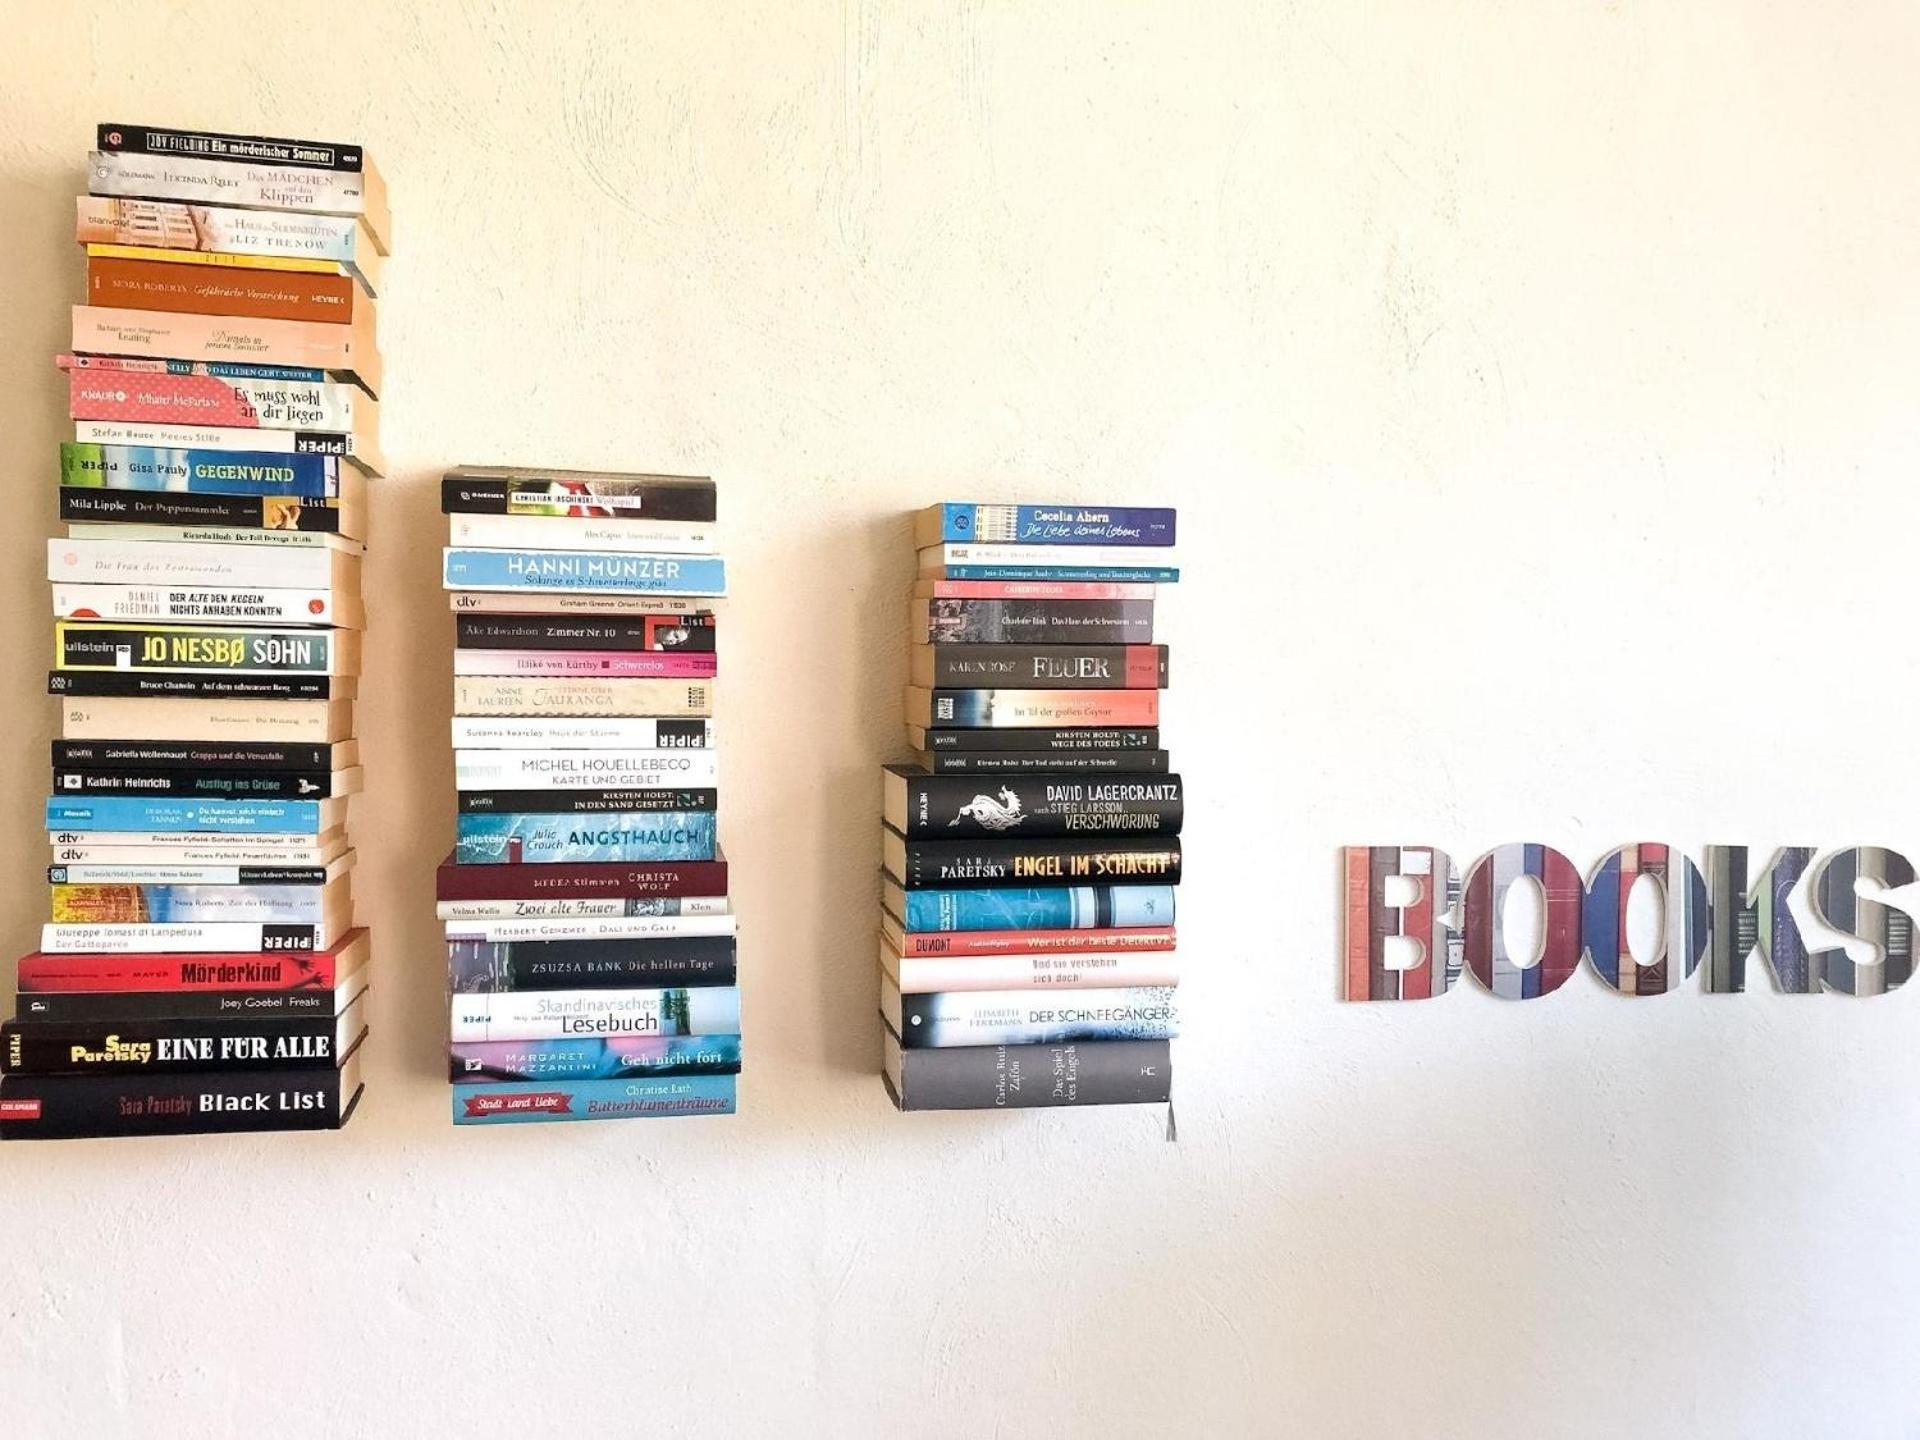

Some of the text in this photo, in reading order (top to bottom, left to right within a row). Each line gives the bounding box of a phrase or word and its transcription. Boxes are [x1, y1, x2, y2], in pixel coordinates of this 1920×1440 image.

[150, 135, 167, 148] JOY
[170, 136, 210, 152] FIELDING
[211, 138, 228, 151] Ein
[229, 141, 290, 158] mörderischer
[292, 147, 330, 162] Sommer
[260, 188, 313, 205] Klippen
[235, 234, 328, 251] LIZ TRENOW
[112, 279, 141, 289] NORA
[234, 387, 321, 407] Es muss wohl
[240, 405, 324, 425] an dir liegen
[298, 440, 341, 453] PIPER
[81, 460, 118, 471] PIPER
[128, 464, 295, 482] Gisa Pauly GEGENWIND
[300, 496, 326, 507] List
[515, 494, 552, 503] CHRISTIAN
[69, 499, 127, 512] Mila Lippke
[1035, 510, 1110, 523] Cecelia Ahern
[1045, 523, 1071, 537] Liebe
[508, 554, 680, 579] HANNI MÜNZER
[169, 593, 209, 603] DER ALTE
[457, 596, 477, 607] dtv
[114, 602, 160, 615] FRIEDMAN
[169, 604, 242, 616] NICHTS ANHABEN
[680, 615, 704, 626] List
[487, 625, 539, 636] Edwardson
[546, 627, 585, 637] Zimmer
[586, 628, 602, 637] Nr.
[604, 628, 616, 637] 10
[65, 642, 114, 653] ullstein
[141, 636, 245, 667] JO NESBØ
[252, 638, 311, 665] SOHN
[949, 661, 987, 673] KAREN
[1033, 656, 1112, 678] FEUER
[140, 680, 196, 690] Bruce Chatwin
[201, 681, 233, 691] Auf dem
[494, 687, 523, 695] ANNE
[659, 734, 698, 748] PIPER
[1050, 740, 1073, 748] WEGE
[1074, 740, 1092, 748] DES
[106, 750, 187, 760] Gabriella Wollenhaupt
[234, 752, 245, 760] die
[521, 758, 691, 772] MICHEL HOUELLEBECQ
[86, 775, 171, 789] Kathrin Heinrichs
[195, 779, 281, 792] Ausflug ins Grüne
[552, 775, 661, 785] KARTE UND GEBIET
[1047, 784, 1178, 801] DAVID LAGERCRANTZ
[575, 801, 586, 809] IN
[587, 801, 605, 809] DEN
[607, 800, 634, 809] SAND
[1050, 802, 1123, 814] STIEG LARSSON
[57, 833, 78, 843] dtv
[462, 834, 509, 844] ullstein
[526, 838, 564, 850] Crouch
[568, 829, 700, 846] ANGSTHAUCH
[61, 849, 83, 860] dtv
[1015, 853, 1168, 876] ENGEL IM SCHACHT
[628, 872, 680, 883] CHRISTA
[941, 865, 1007, 878] PARETSKY
[515, 902, 574, 916] Zwei alte
[1334, 842, 1920, 1001] BOOKS
[139, 928, 148, 937] di
[265, 936, 309, 950] PIPER
[532, 962, 582, 973] ZSUZSA
[629, 959, 715, 971] Die hellen Tage
[181, 962, 281, 984] Mörderkind
[220, 997, 320, 1010] Joey Goebel Freaks
[536, 996, 658, 1013] Skandinavisches
[462, 1015, 491, 1024] PIPER
[1029, 1006, 1170, 1024] DER SCHNEEGÄNGER
[562, 1012, 658, 1033] Lesebuch
[105, 1034, 151, 1052] Sara
[156, 1035, 330, 1061] EINE FÜR ALLE
[10, 1033, 22, 1067] PIPER
[70, 1044, 151, 1065] Paretsky
[505, 1052, 585, 1063] MARGARET
[621, 1051, 722, 1067] Geh nicht fort
[505, 1062, 597, 1073] MAZZANTINI
[1052, 1048, 1064, 1098] Das Spiel
[1065, 1045, 1077, 1101] des Engels
[119, 1091, 326, 1116] Sara Paretsky Black List
[477, 1097, 502, 1109] Stadt
[535, 1096, 559, 1108] Liebe
